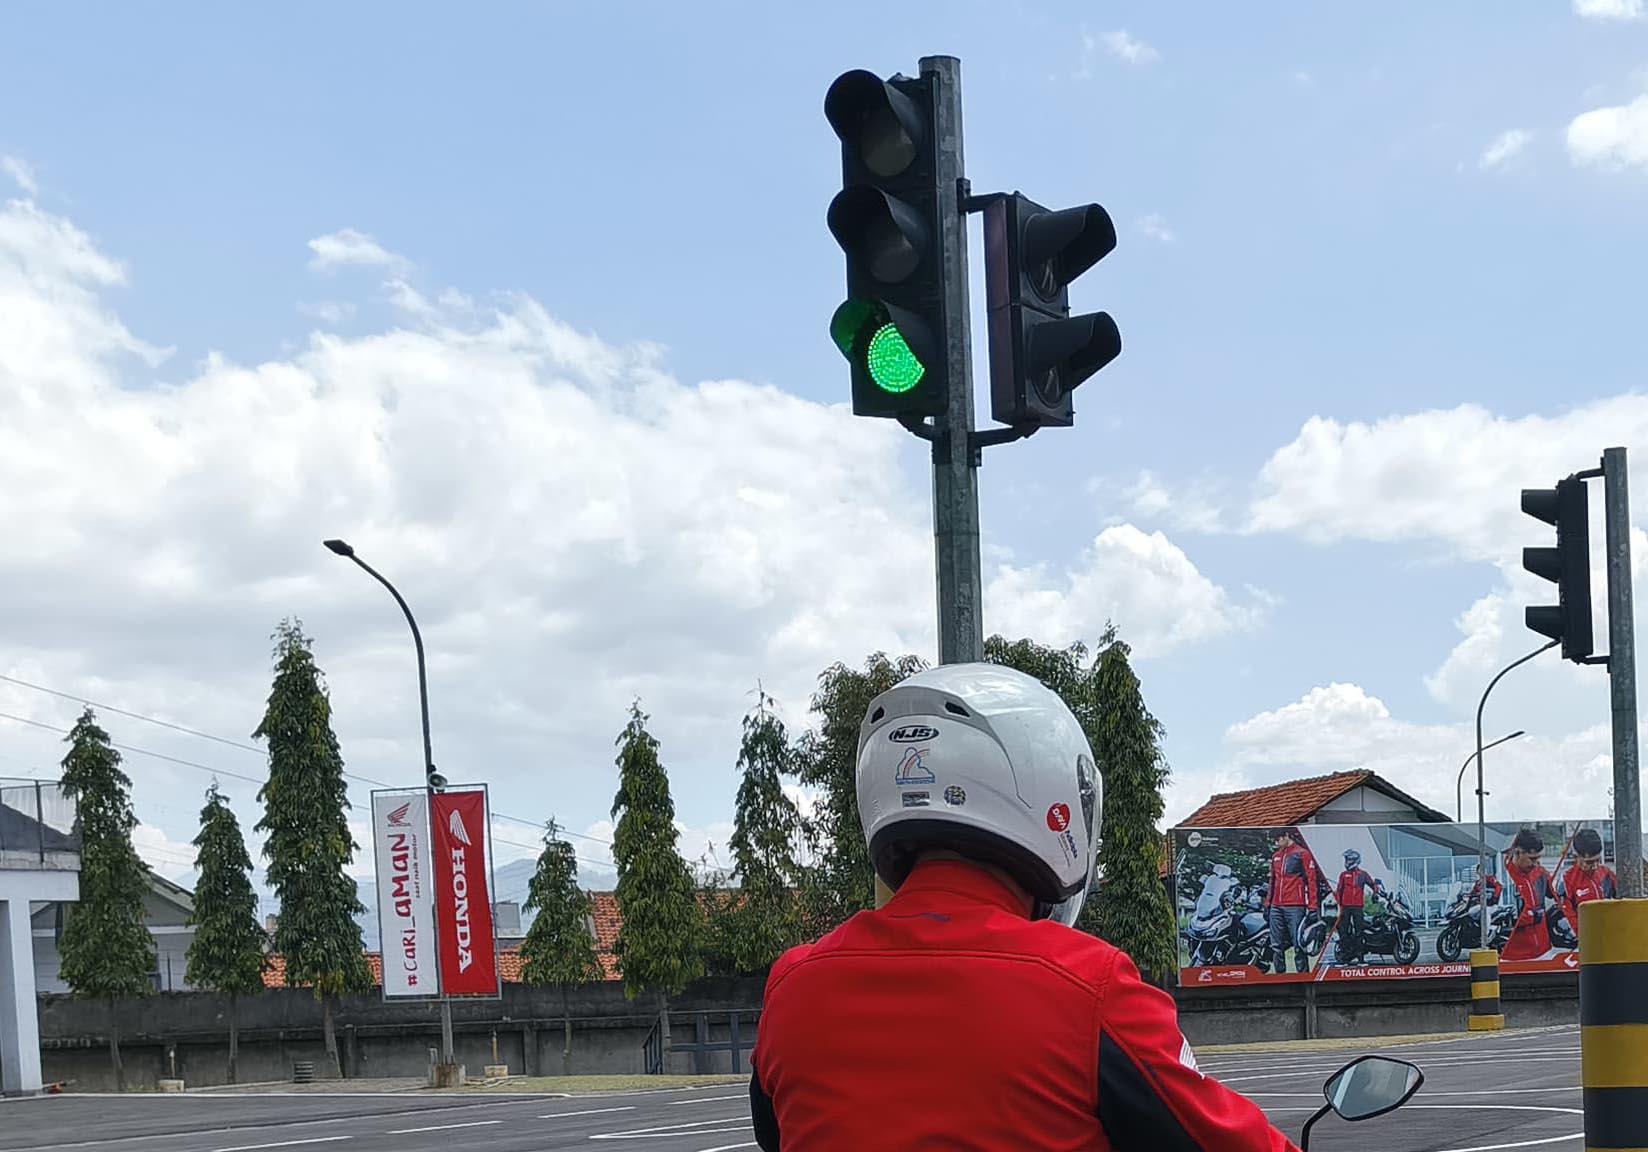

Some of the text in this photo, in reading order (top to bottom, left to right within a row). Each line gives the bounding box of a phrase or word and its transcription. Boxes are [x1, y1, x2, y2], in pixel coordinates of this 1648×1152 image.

[451, 847, 473, 974] HONDA
[1340, 969, 1365, 978] TOTAL
[1367, 967, 1405, 977] CONTROL
[1407, 966, 1440, 975] ACROSS
